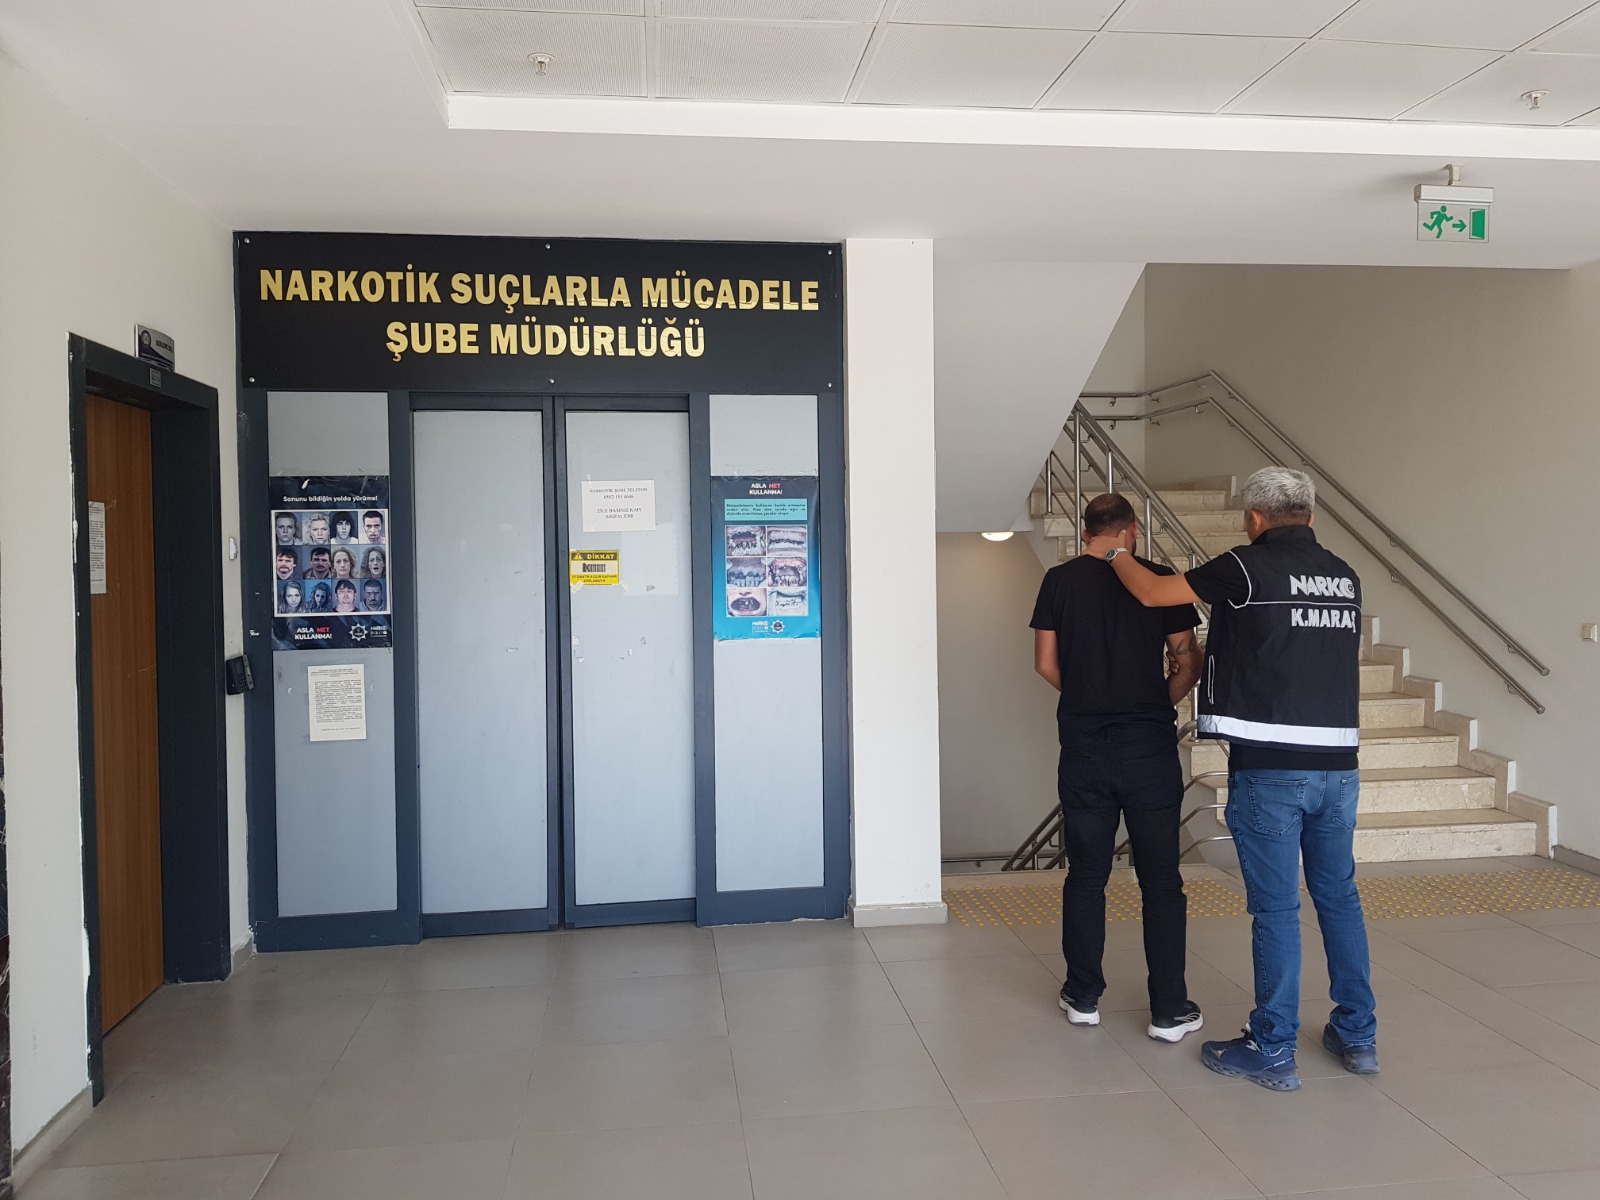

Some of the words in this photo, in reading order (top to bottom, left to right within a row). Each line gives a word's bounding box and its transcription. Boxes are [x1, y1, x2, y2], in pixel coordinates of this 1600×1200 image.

[260, 263, 441, 303] NARKOTİK
[451, 273, 632, 314] SUÇLARLA
[642, 270, 819, 311] MÜCADELE
[386, 322, 480, 362] ŞUBE
[491, 316, 705, 358] MÜDÜRLÜĞÜ
[308, 495, 332, 503] bildiğin
[333, 495, 351, 503] yolda
[352, 495, 378, 503] yürüme!
